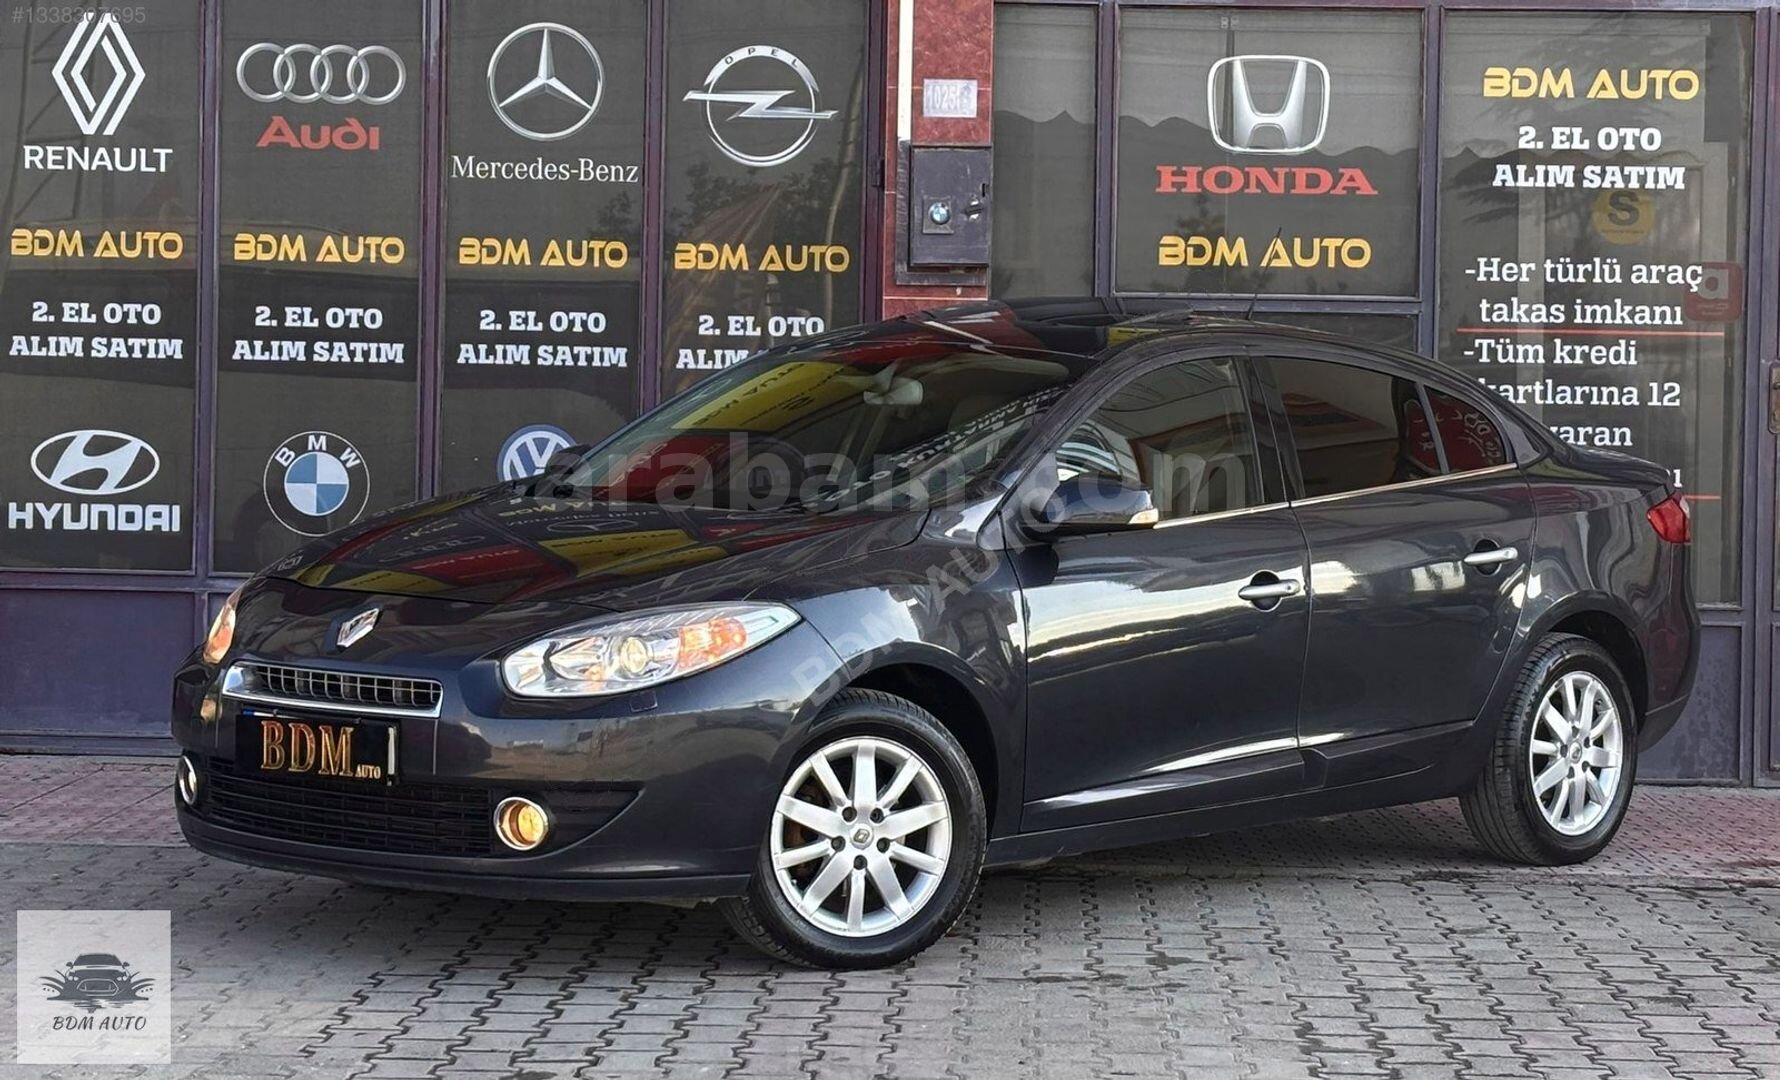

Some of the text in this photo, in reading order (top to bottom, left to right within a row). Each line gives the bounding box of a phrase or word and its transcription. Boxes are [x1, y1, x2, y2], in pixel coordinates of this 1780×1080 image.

[724, 46, 799, 68] OPEL
[1483, 67, 1700, 100] BDM AUTO
[258, 116, 380, 151] Audi
[1517, 125, 1662, 151] 2. EL OTO
[22, 144, 174, 173] RENAULT
[451, 155, 639, 183] Mercedes-Benz
[1156, 164, 1377, 196] HONDA
[1492, 164, 1686, 191] ALIM SATIM
[10, 228, 184, 260] BDM AUTO
[233, 232, 405, 265] BDM AUTO
[458, 237, 628, 269] BDM AUTO
[674, 242, 850, 273] BDM AUTO
[1158, 235, 1372, 269] BDM AUTO
[1464, 256, 1537, 283] -Her
[1543, 256, 1623, 284] türlü
[1630, 263, 1704, 293] araç
[32, 301, 162, 325] 2. EL OTO
[254, 305, 383, 330] 2. EL OTO
[479, 309, 607, 334] 2. EL OTO
[698, 314, 825, 337] 2. EL OTO
[1479, 296, 1566, 324] takas
[1573, 297, 1684, 326] imkanı
[8, 335, 184, 360] ALIM SATIM
[231, 339, 405, 364] ALIM SATIM
[456, 343, 628, 368] ALIM SATIM
[675, 348, 750, 370] ALIM
[1463, 337, 1639, 366] -Tüm kredi
[1647, 381, 1681, 407] 12
[275, 434, 362, 469] BMW
[8, 501, 181, 532] HYUNDAI
[261, 720, 354, 777] BDM
[354, 763, 382, 780] AUTO
